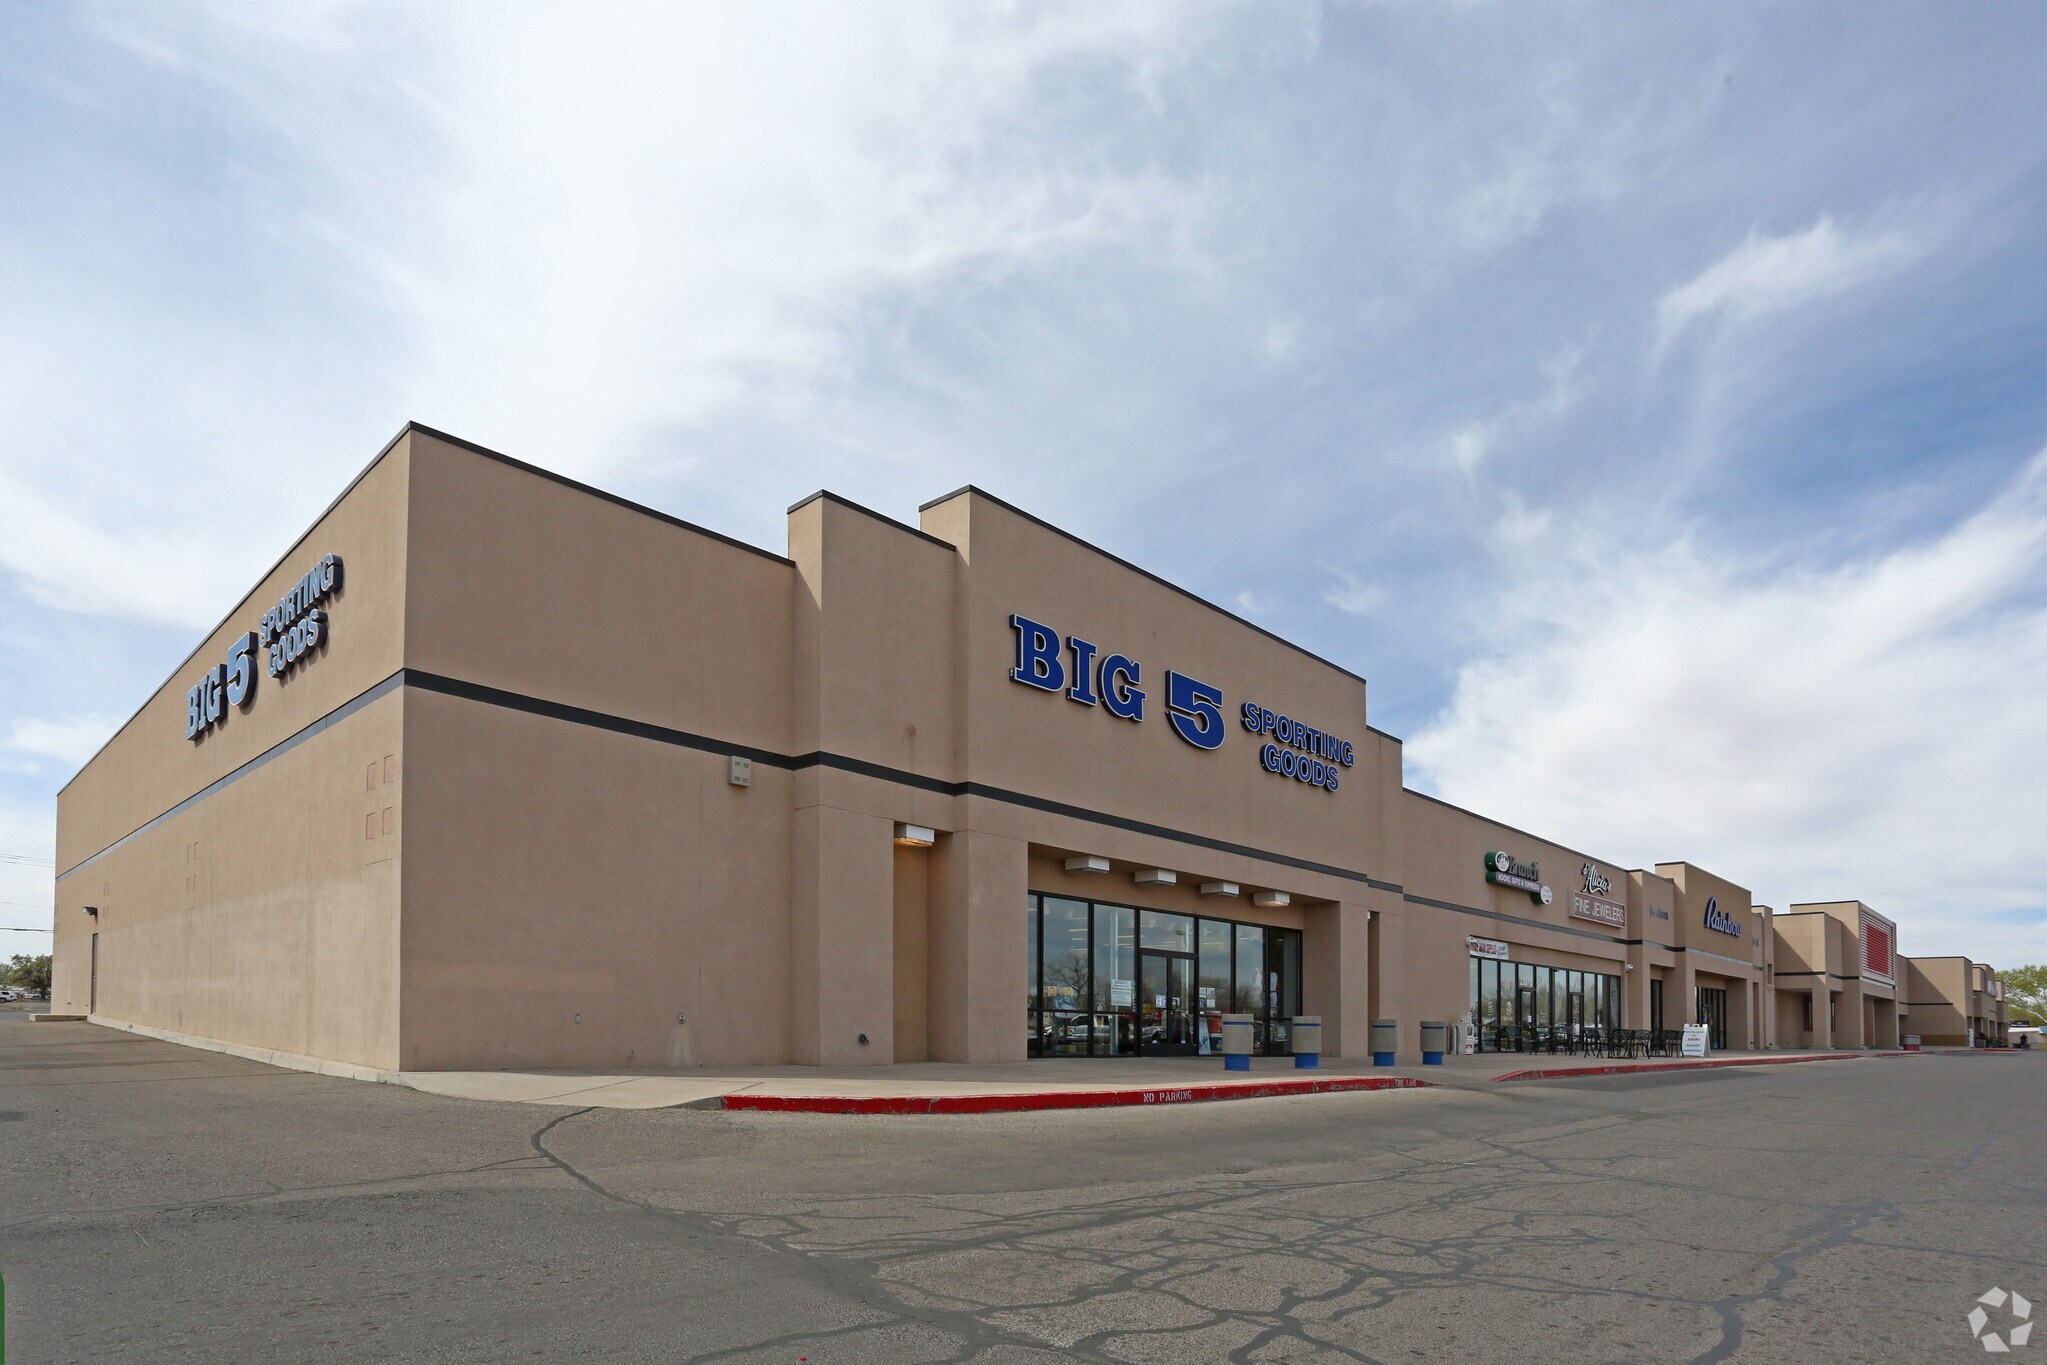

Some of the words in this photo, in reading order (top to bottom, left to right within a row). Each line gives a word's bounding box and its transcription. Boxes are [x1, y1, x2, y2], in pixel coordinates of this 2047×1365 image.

[259, 553, 342, 648] SPORTING
[267, 609, 328, 677] GOODS
[186, 663, 226, 741] BIG
[227, 631, 258, 706] 5
[1009, 614, 1146, 722] BIG
[1165, 670, 1225, 750] 5
[1241, 701, 1354, 767] SPORTING
[1260, 743, 1340, 792] GOODS
[1575, 898, 1590, 914] FINE
[1592, 903, 1624, 923] JEWELERS
[1704, 897, 1742, 937] Rainbow
[1143, 1091, 1155, 1103] NO
[1159, 1089, 1192, 1102] PARKING
